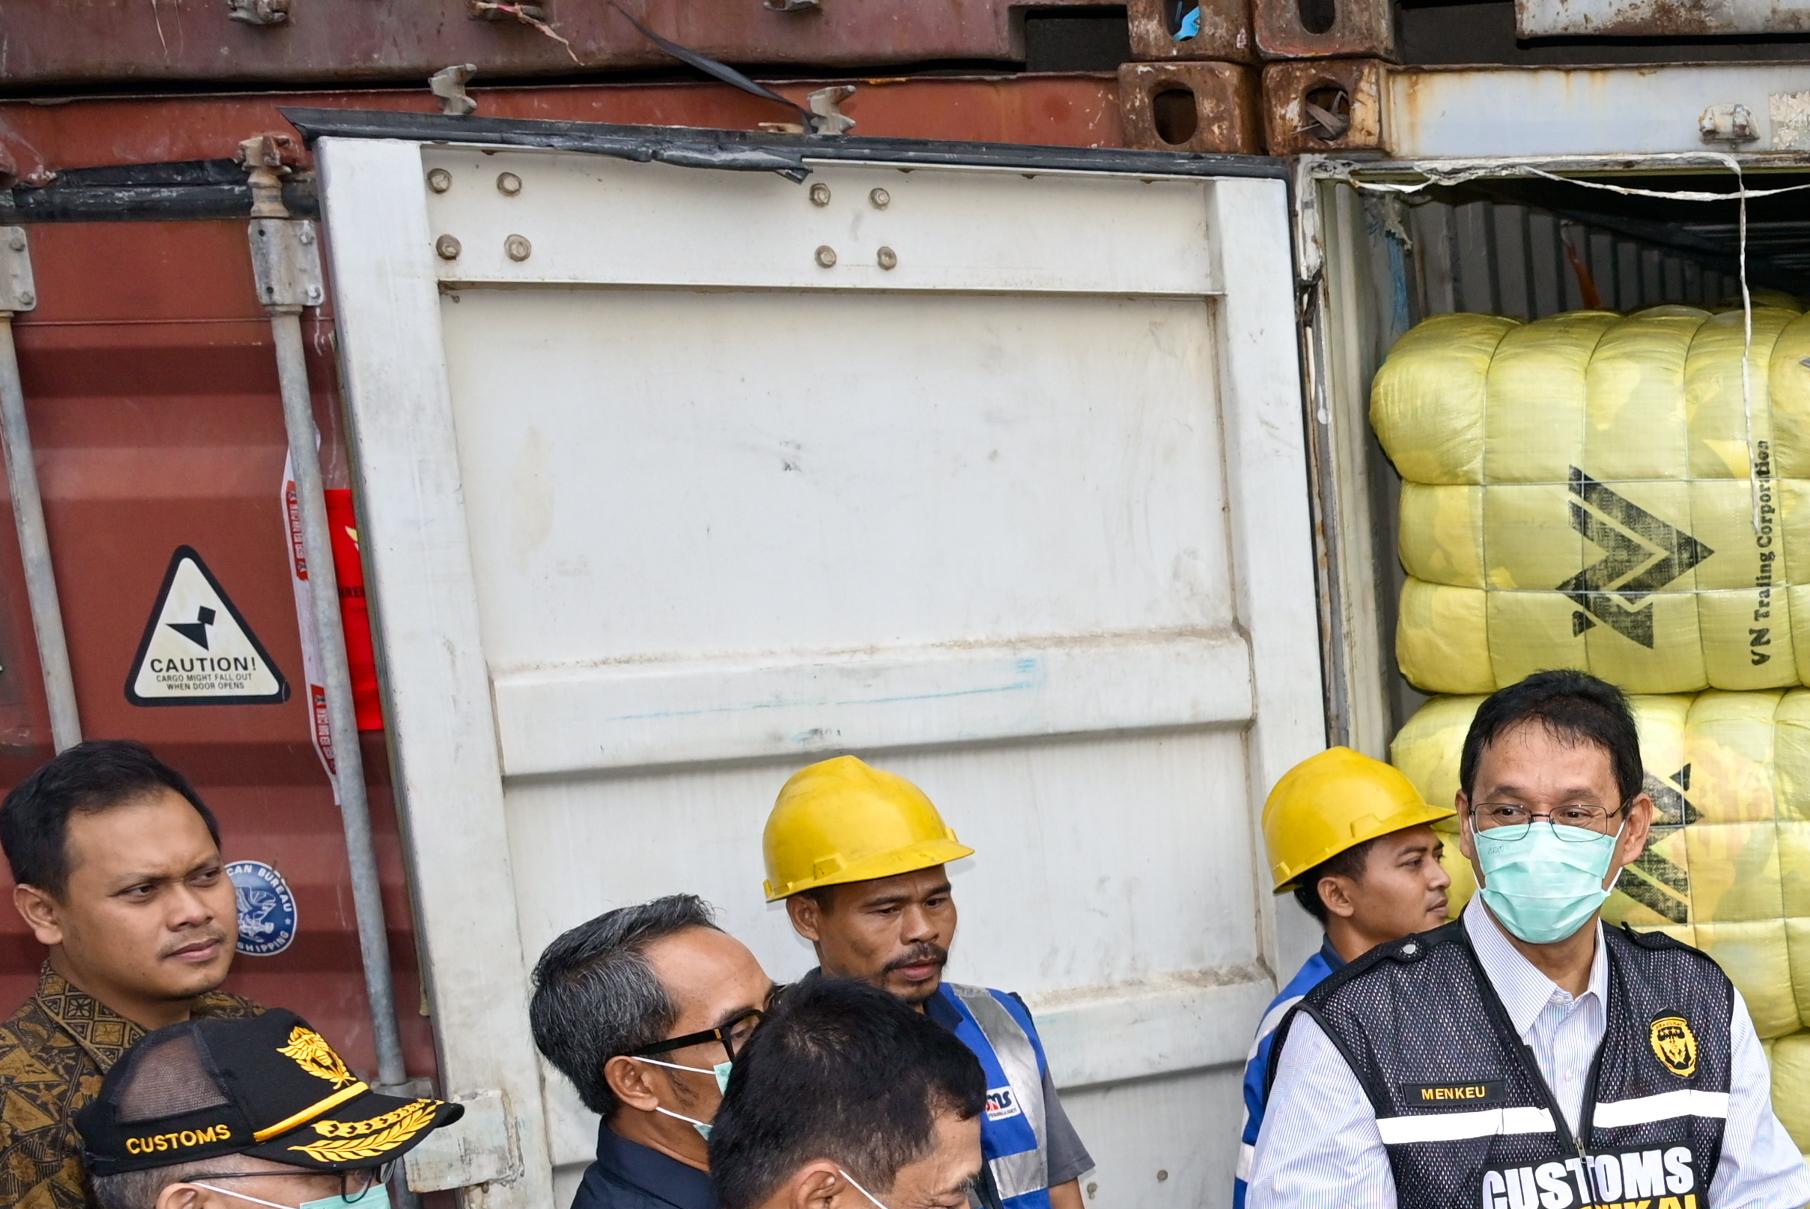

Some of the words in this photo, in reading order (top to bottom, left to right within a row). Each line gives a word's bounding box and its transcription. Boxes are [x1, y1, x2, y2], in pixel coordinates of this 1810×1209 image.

[1748, 627, 1771, 666] VN
[150, 656, 257, 673] CAUTION!
[156, 674, 184, 683] CARGO
[186, 674, 212, 682] MIGHT
[214, 673, 233, 682] FALL
[234, 673, 252, 682] OUT
[166, 683, 191, 691] WHEN
[192, 682, 216, 690] DOOR
[218, 682, 245, 690] OPENS
[257, 867, 293, 912] BUREAU
[237, 930, 289, 953] SHIPPING
[985, 1091, 1012, 1111] MS
[1421, 1086, 1486, 1100] MENKEU
[126, 1124, 231, 1155] CUSTOMS
